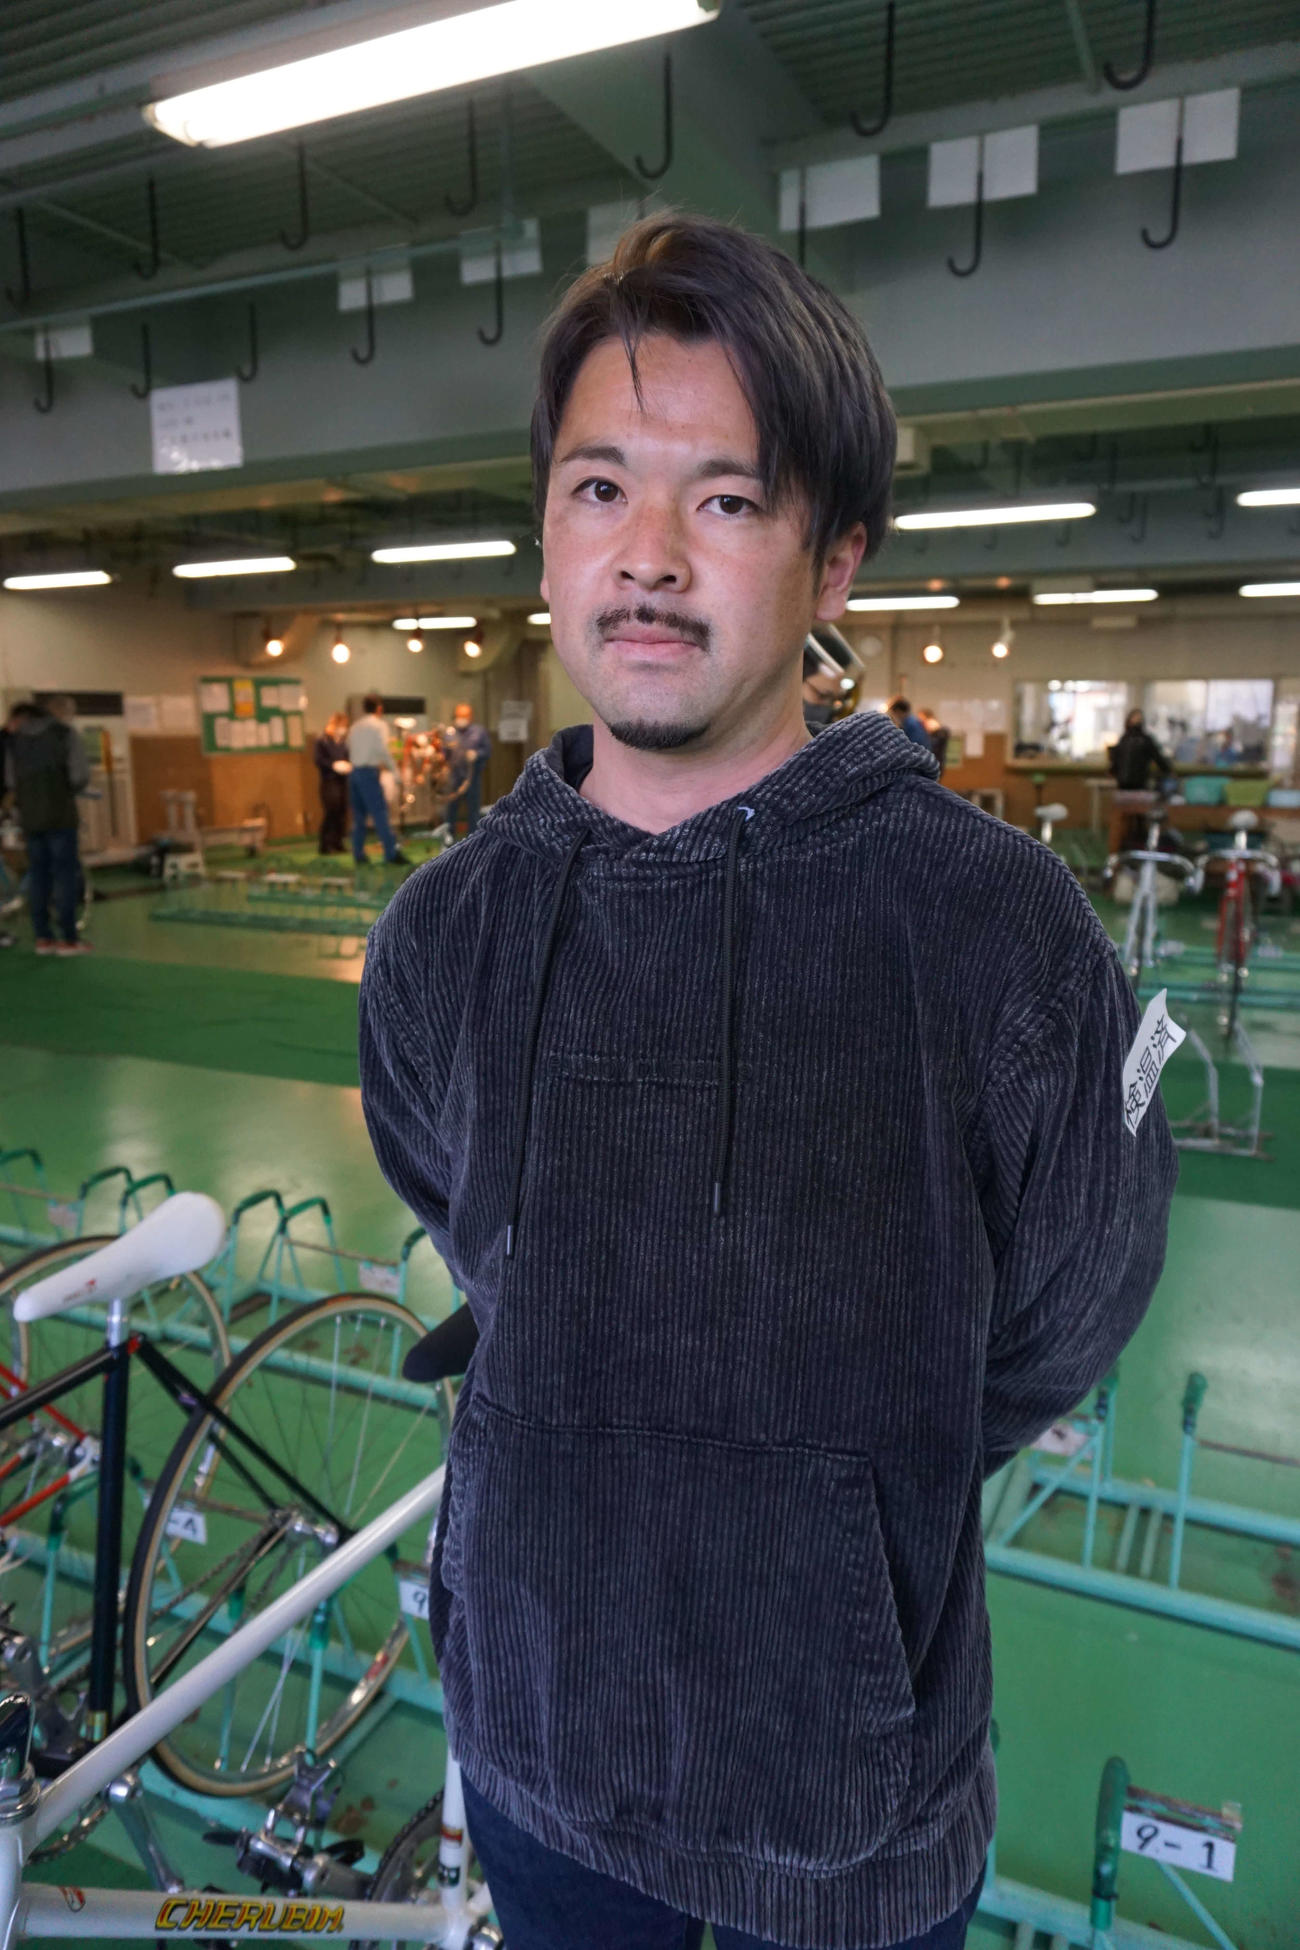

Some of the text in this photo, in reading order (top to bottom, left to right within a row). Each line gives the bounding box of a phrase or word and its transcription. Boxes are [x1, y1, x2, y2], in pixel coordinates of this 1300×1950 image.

[1125, 1013, 1177, 1129] 検温済
[1136, 1824, 1216, 1871] 9-1
[155, 1897, 344, 1932] CHERUBIM
